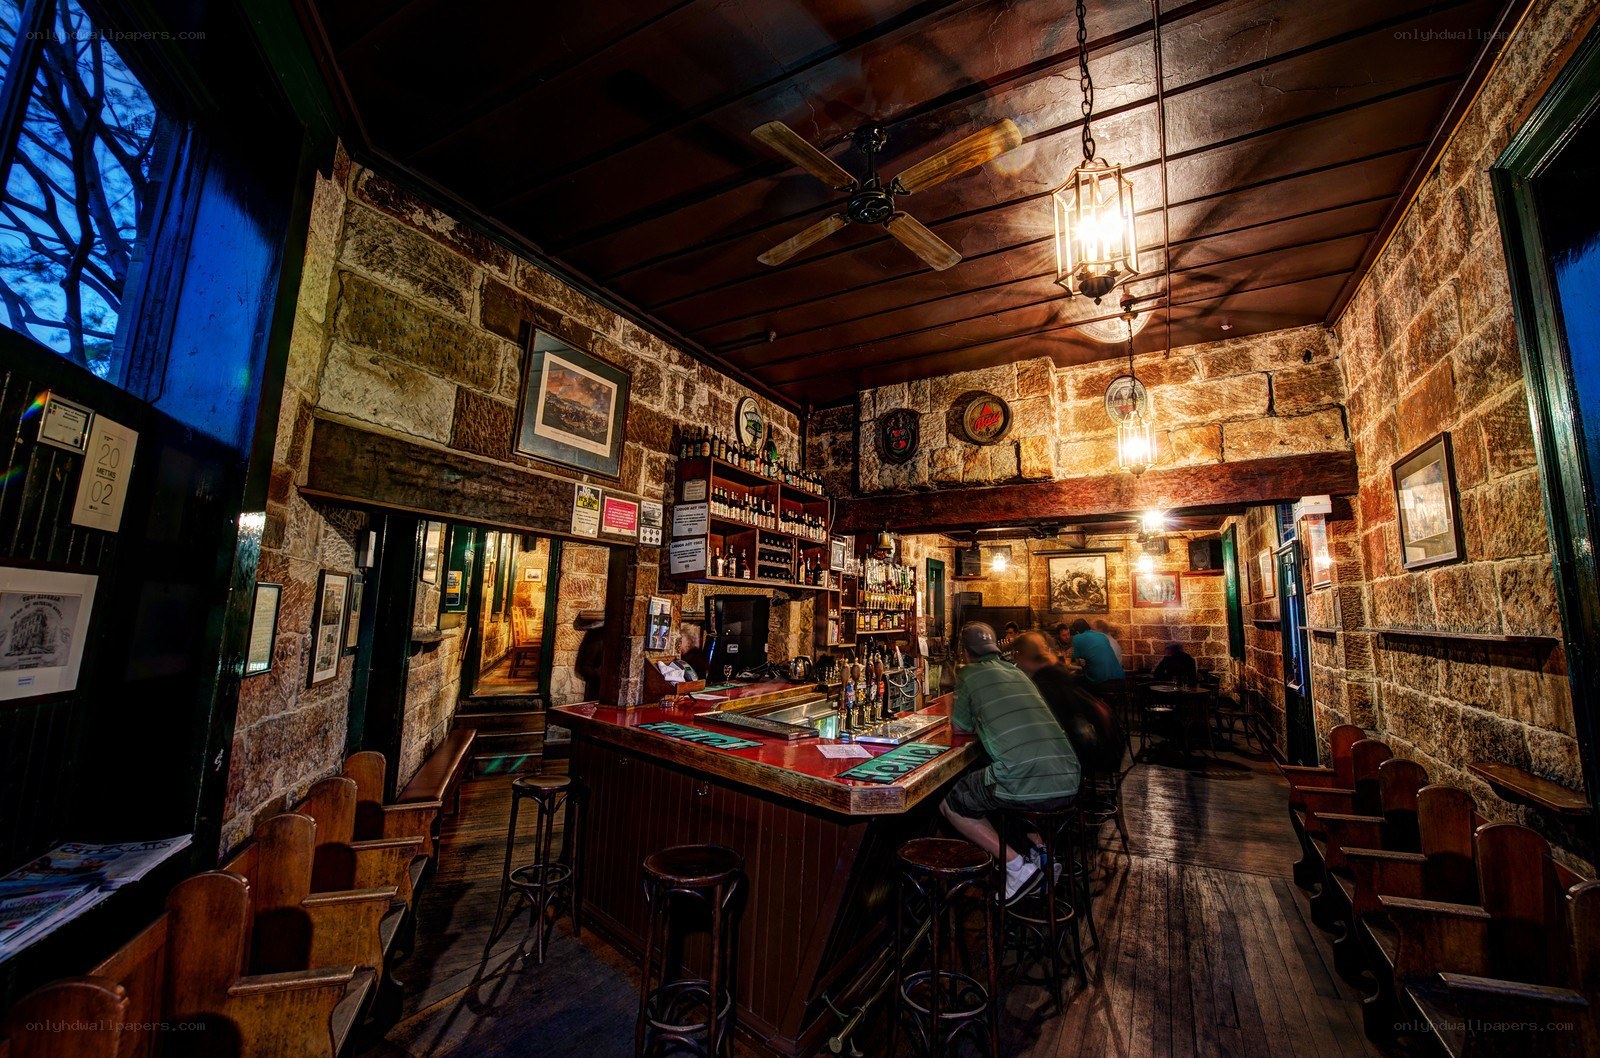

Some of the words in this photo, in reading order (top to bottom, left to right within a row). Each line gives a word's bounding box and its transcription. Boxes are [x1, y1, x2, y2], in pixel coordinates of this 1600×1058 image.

[974, 411, 1002, 431] Bass
[98, 443, 120, 469] 20
[91, 480, 113, 506] 02
